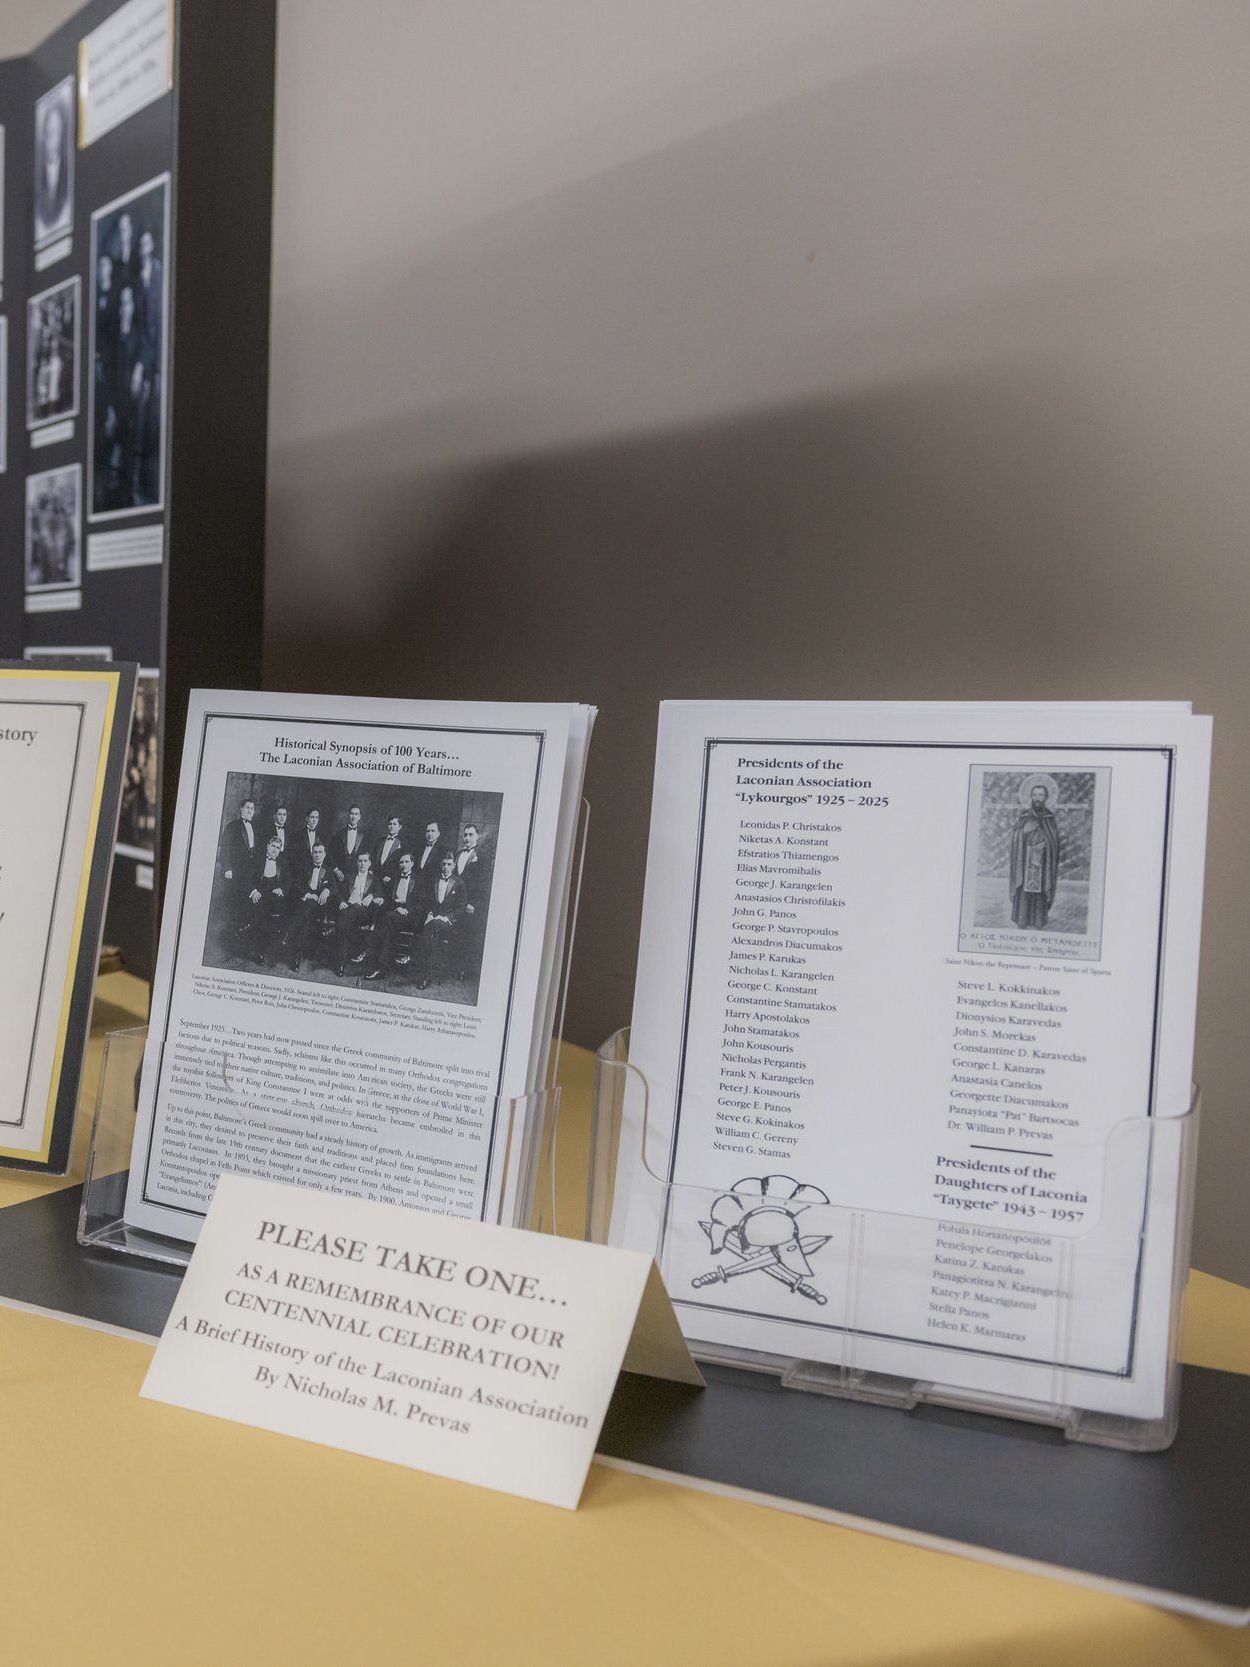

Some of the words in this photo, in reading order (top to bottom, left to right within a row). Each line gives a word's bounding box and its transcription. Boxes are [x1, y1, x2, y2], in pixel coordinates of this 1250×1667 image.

[274, 737, 326, 750] Historical
[329, 740, 377, 756] Synopsis
[380, 744, 393, 755] of
[394, 745, 412, 756] 100
[415, 746, 458, 759] Years...
[259, 751, 280, 763] The
[282, 753, 332, 767] Laconian
[335, 757, 398, 772] Association
[402, 762, 415, 773] of
[416, 763, 471, 777] Baltimore
[737, 757, 803, 768] Presidents
[805, 758, 821, 769] of
[822, 759, 843, 769] the
[736, 774, 793, 785] Laconian
[796, 776, 871, 788] Association
[735, 792, 812, 806] “Lykourgos”
[816, 794, 844, 806] 1925
[857, 796, 888, 807] 2025
[740, 819, 780, 829] Leonidas
[782, 821, 789, 829] P.
[791, 822, 841, 831] Christakos
[738, 834, 773, 843] Niketas
[774, 836, 783, 844] A.
[786, 836, 828, 846] Konstant
[737, 848, 780, 859] Efstratios
[781, 850, 839, 863] Thiamengos
[736, 863, 757, 872] Elias
[758, 864, 821, 875] Mavromihalis
[735, 878, 769, 889] George
[769, 879, 776, 889] J.
[779, 880, 832, 891] Karangelen
[734, 892, 782, 903] Anastasios
[783, 895, 845, 907] Christofilakis
[731, 906, 754, 916] John
[756, 908, 766, 916] G.
[769, 909, 796, 919] Panos
[731, 921, 766, 932] George
[767, 923, 775, 932] P.
[777, 924, 838, 936] Stavropoulos
[730, 936, 783, 947] Alexandros
[784, 939, 843, 951] Diacumakos
[728, 950, 757, 960] James
[758, 952, 766, 961] P.
[768, 953, 806, 964] Karukas
[728, 965, 769, 976] Nicholas
[770, 968, 778, 976] L.
[781, 969, 834, 981] Karangelen
[727, 979, 761, 991] George
[763, 982, 772, 991] C.
[775, 983, 817, 995] Konstant
[957, 980, 985, 990] Steve
[986, 982, 995, 991] L.
[998, 983, 1060, 996] Kokkinakos
[956, 995, 1008, 1008] Evangelos
[955, 1010, 1006, 1023] Dionysios
[1007, 1015, 1062, 1028] Karavedas
[952, 1026, 978, 1037] John
[980, 1028, 989, 1037] S.
[179, 1019, 210, 1030] September
[246, 1031, 262, 1039] years
[263, 1033, 275, 1041] had
[290, 1039, 312, 1047] passed
[331, 1044, 342, 1052] the
[342, 1046, 363, 1056] Greek
[364, 1051, 402, 1063] community
[411, 1057, 444, 1069] Baltimore
[444, 1064, 459, 1072] split
[475, 1070, 490, 1078] rival
[953, 1042, 1016, 1056] Constantine
[1017, 1047, 1029, 1057] D.
[1031, 1049, 1086, 1062] Karavedas
[951, 1057, 990, 1070] George
[991, 1061, 1000, 1070] L.
[712, 1141, 743, 1152] Steven
[745, 1145, 756, 1154] G.
[757, 1146, 790, 1158] Stamas
[936, 1155, 1010, 1174] Presidents
[1013, 1165, 1030, 1176] of
[1032, 1167, 1056, 1179] the
[934, 1174, 1008, 1192] Daughters
[1010, 1184, 1028, 1195] of
[1030, 1186, 1087, 1203] Laconia
[933, 1193, 999, 1210] “Taygete”
[1004, 1202, 1035, 1216] 1943
[1051, 1208, 1084, 1221] 1957
[256, 1220, 367, 1262] PLEASE
[376, 1244, 457, 1281] TAKE
[464, 1265, 566, 1306] ONE...
[236, 1262, 262, 1279] AS
[265, 1268, 278, 1284] A
[285, 1272, 466, 1326] REMEMBRANCE
[471, 1315, 506, 1334] OF
[510, 1323, 564, 1348] OUR
[224, 1289, 371, 1337] CENTENNIAL
[377, 1325, 559, 1380] CELEBRATION!
[175, 1315, 187, 1331] A
[193, 1318, 241, 1343] Brief
[240, 1330, 309, 1365] History
[313, 1351, 337, 1366] of
[337, 1355, 366, 1375] the
[371, 1361, 462, 1398] Laconian
[469, 1386, 588, 1428] Association
[253, 1365, 279, 1389] By
[283, 1372, 367, 1407] Nicholas
[372, 1394, 397, 1416] M.
[405, 1402, 470, 1433] Prevas
